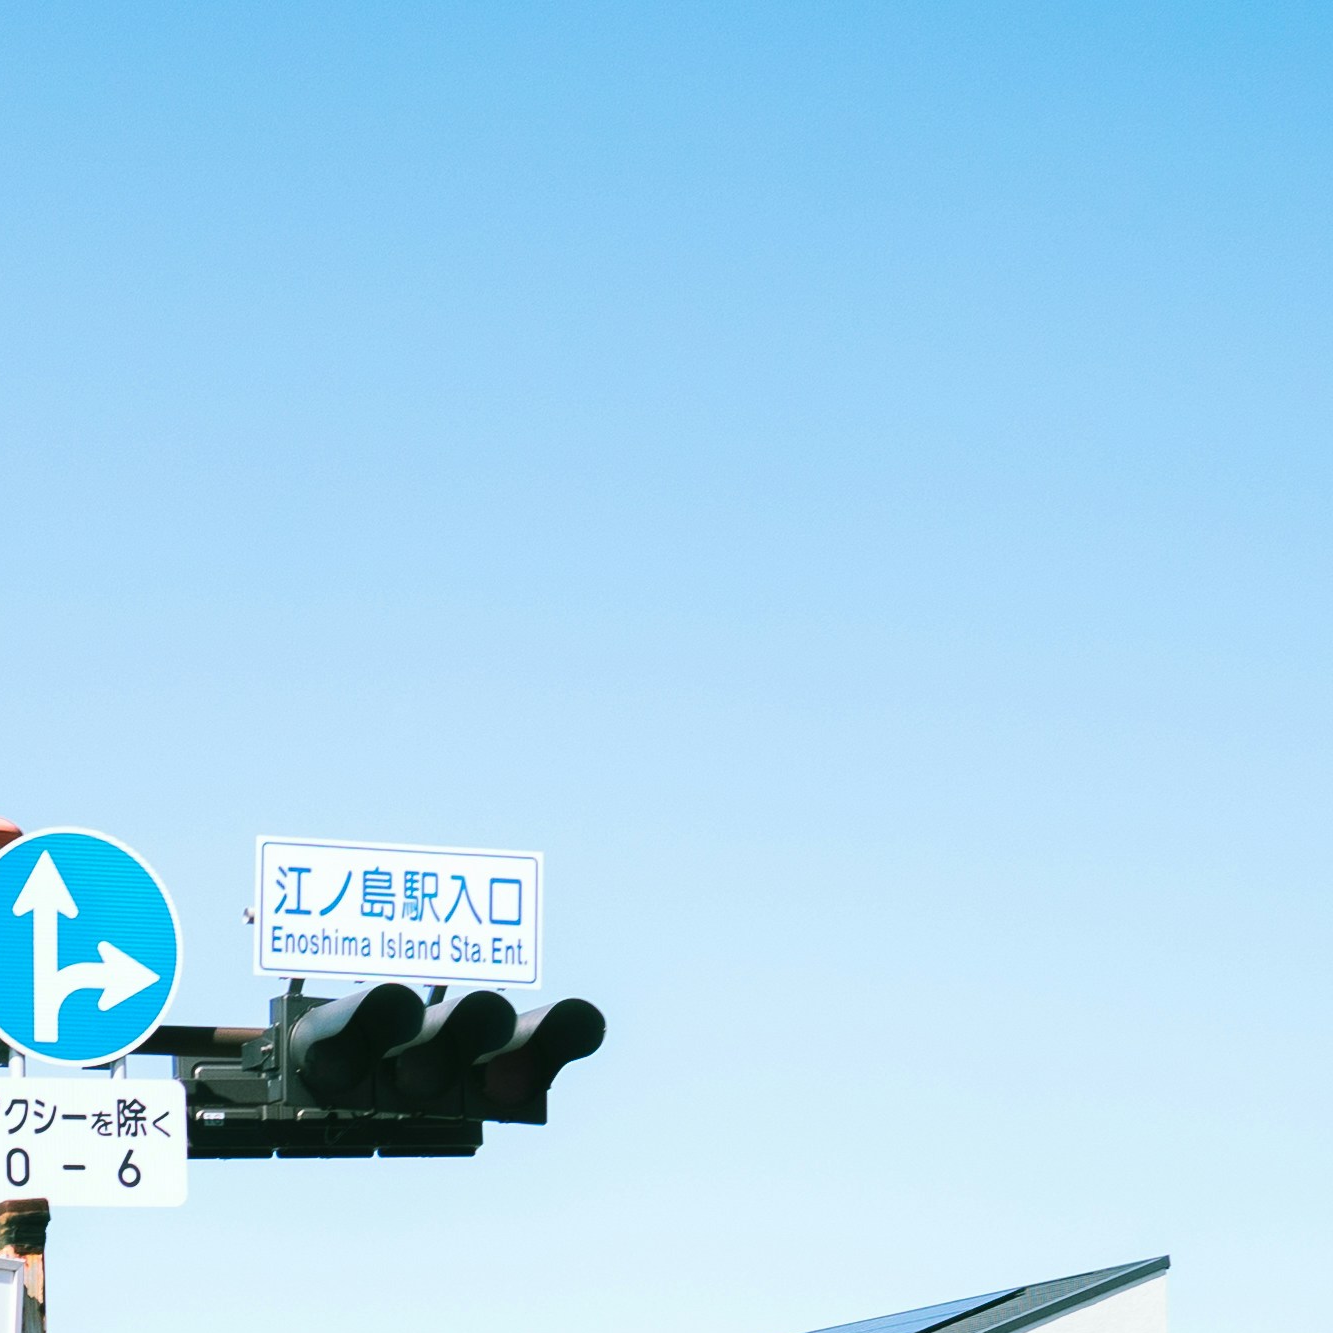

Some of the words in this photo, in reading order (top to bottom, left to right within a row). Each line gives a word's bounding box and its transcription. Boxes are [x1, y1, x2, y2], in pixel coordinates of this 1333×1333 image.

[273, 864, 524, 928] 江ノ島駅入口
[271, 925, 372, 960] Enoshima
[379, 933, 442, 962] Island
[450, 935, 488, 964] Sta.
[491, 936, 529, 967] Ent.
